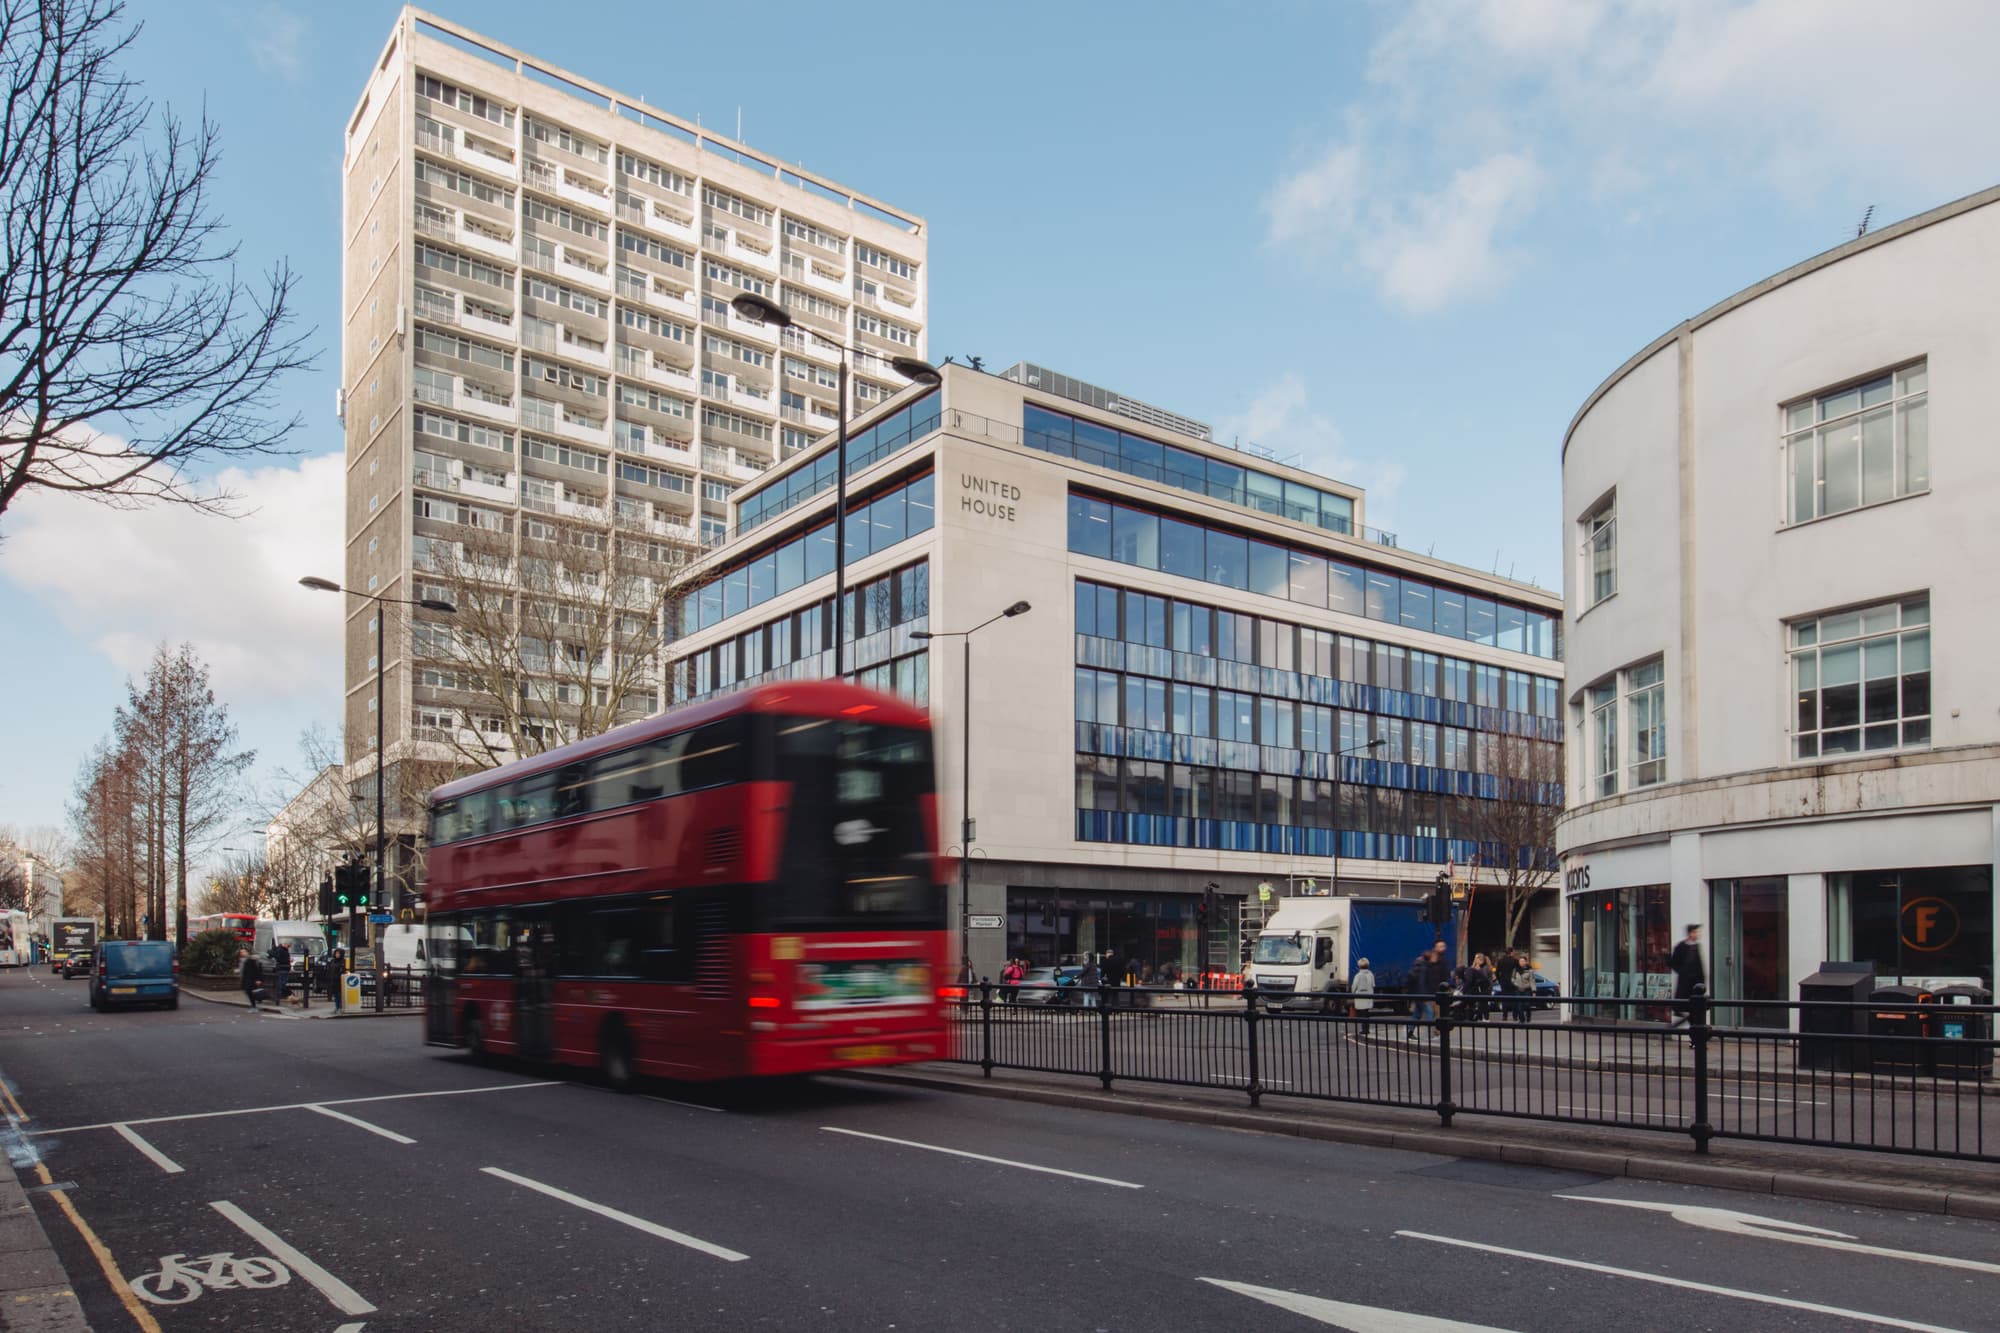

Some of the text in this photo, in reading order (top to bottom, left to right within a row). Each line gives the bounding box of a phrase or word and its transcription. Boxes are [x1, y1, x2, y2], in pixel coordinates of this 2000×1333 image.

[961, 473, 1021, 501] UNITED
[961, 496, 1016, 522] HOUSE
[1916, 906, 1939, 944] F
